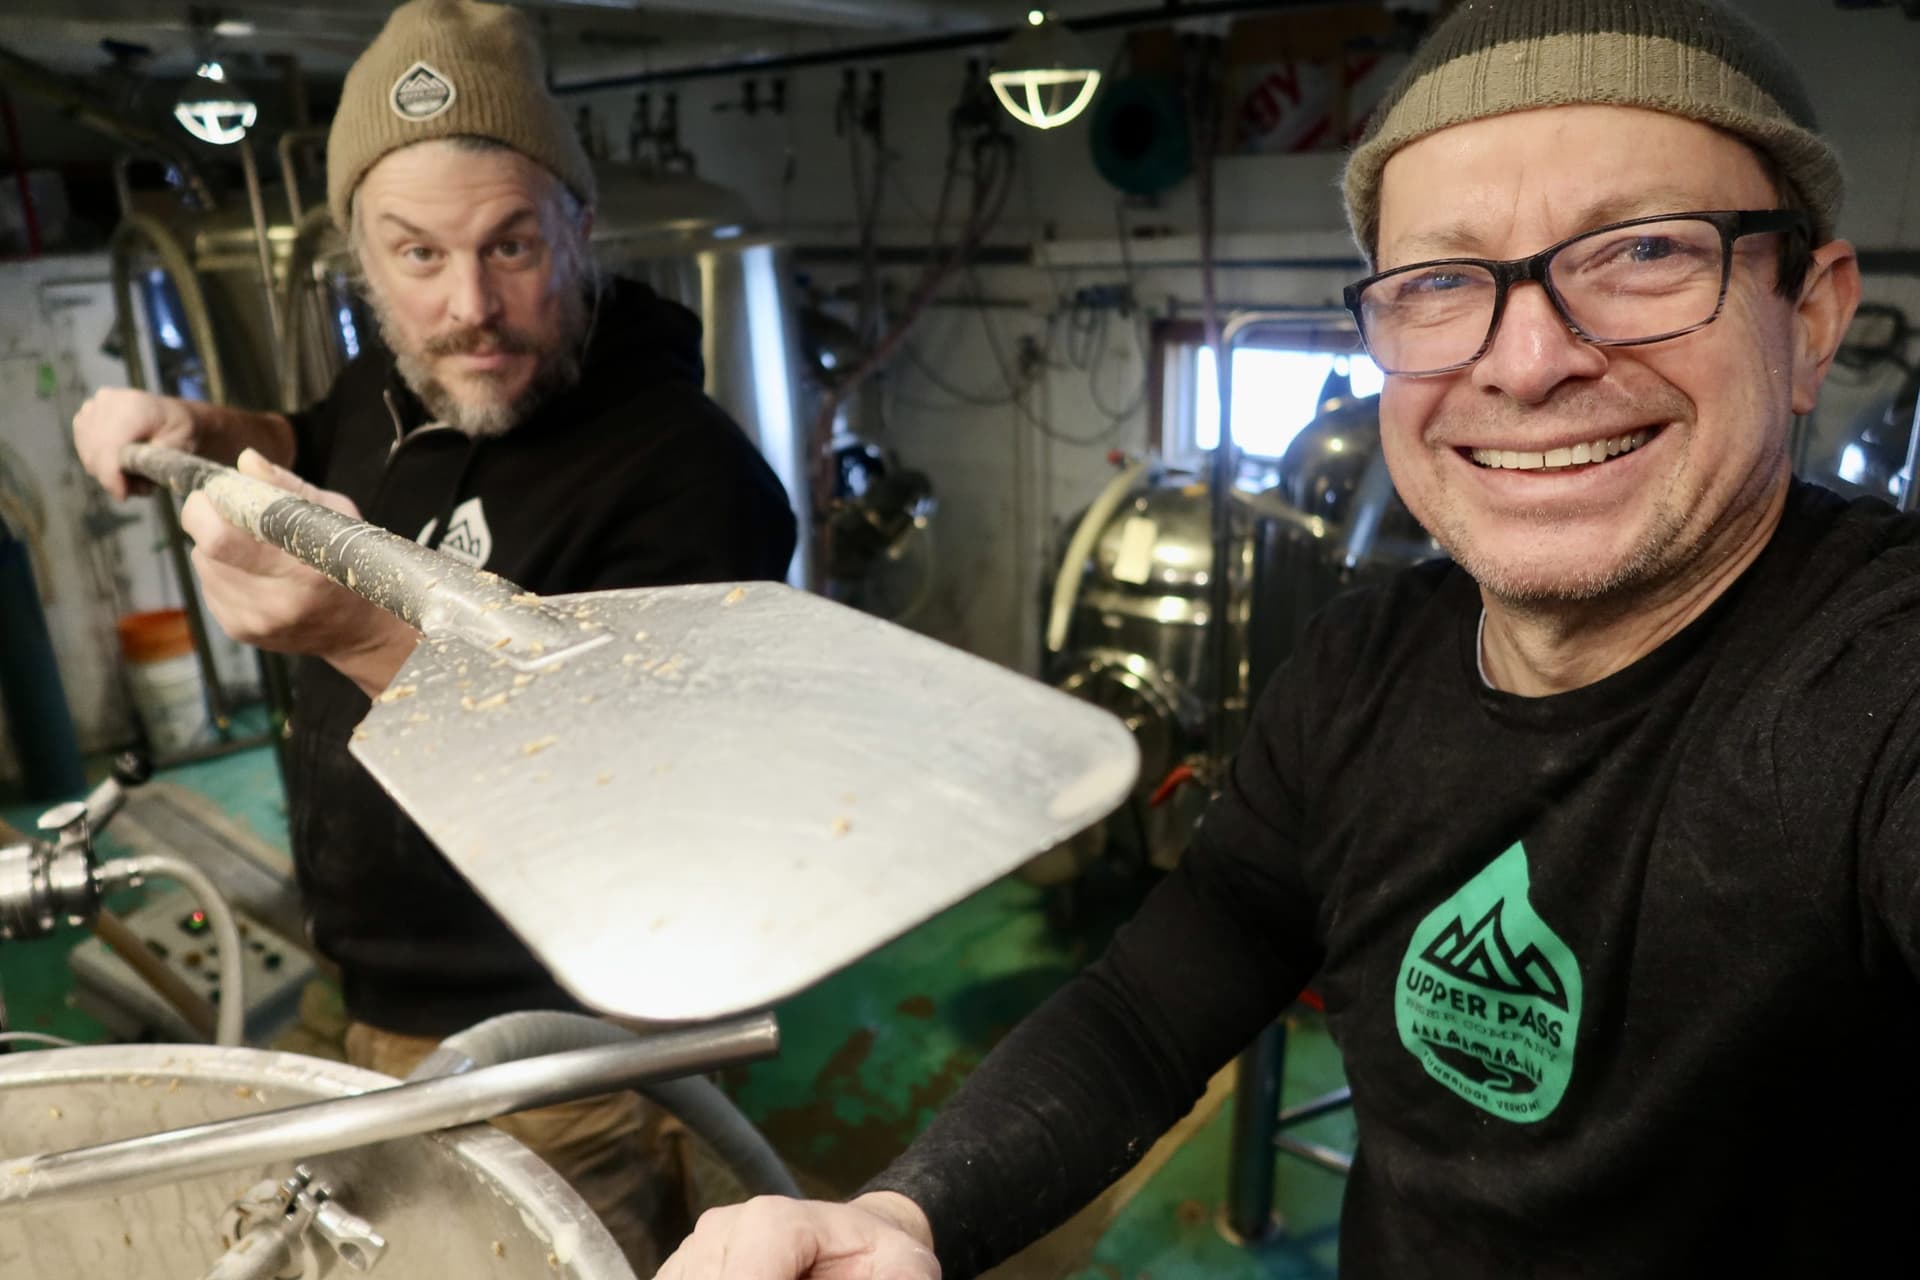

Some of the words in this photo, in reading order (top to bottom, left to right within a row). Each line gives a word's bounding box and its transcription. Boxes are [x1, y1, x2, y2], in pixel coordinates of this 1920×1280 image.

[1406, 966, 1488, 1020] UPPER
[1498, 1002, 1563, 1048] PASS
[1463, 1020, 1557, 1062] COMPANY
